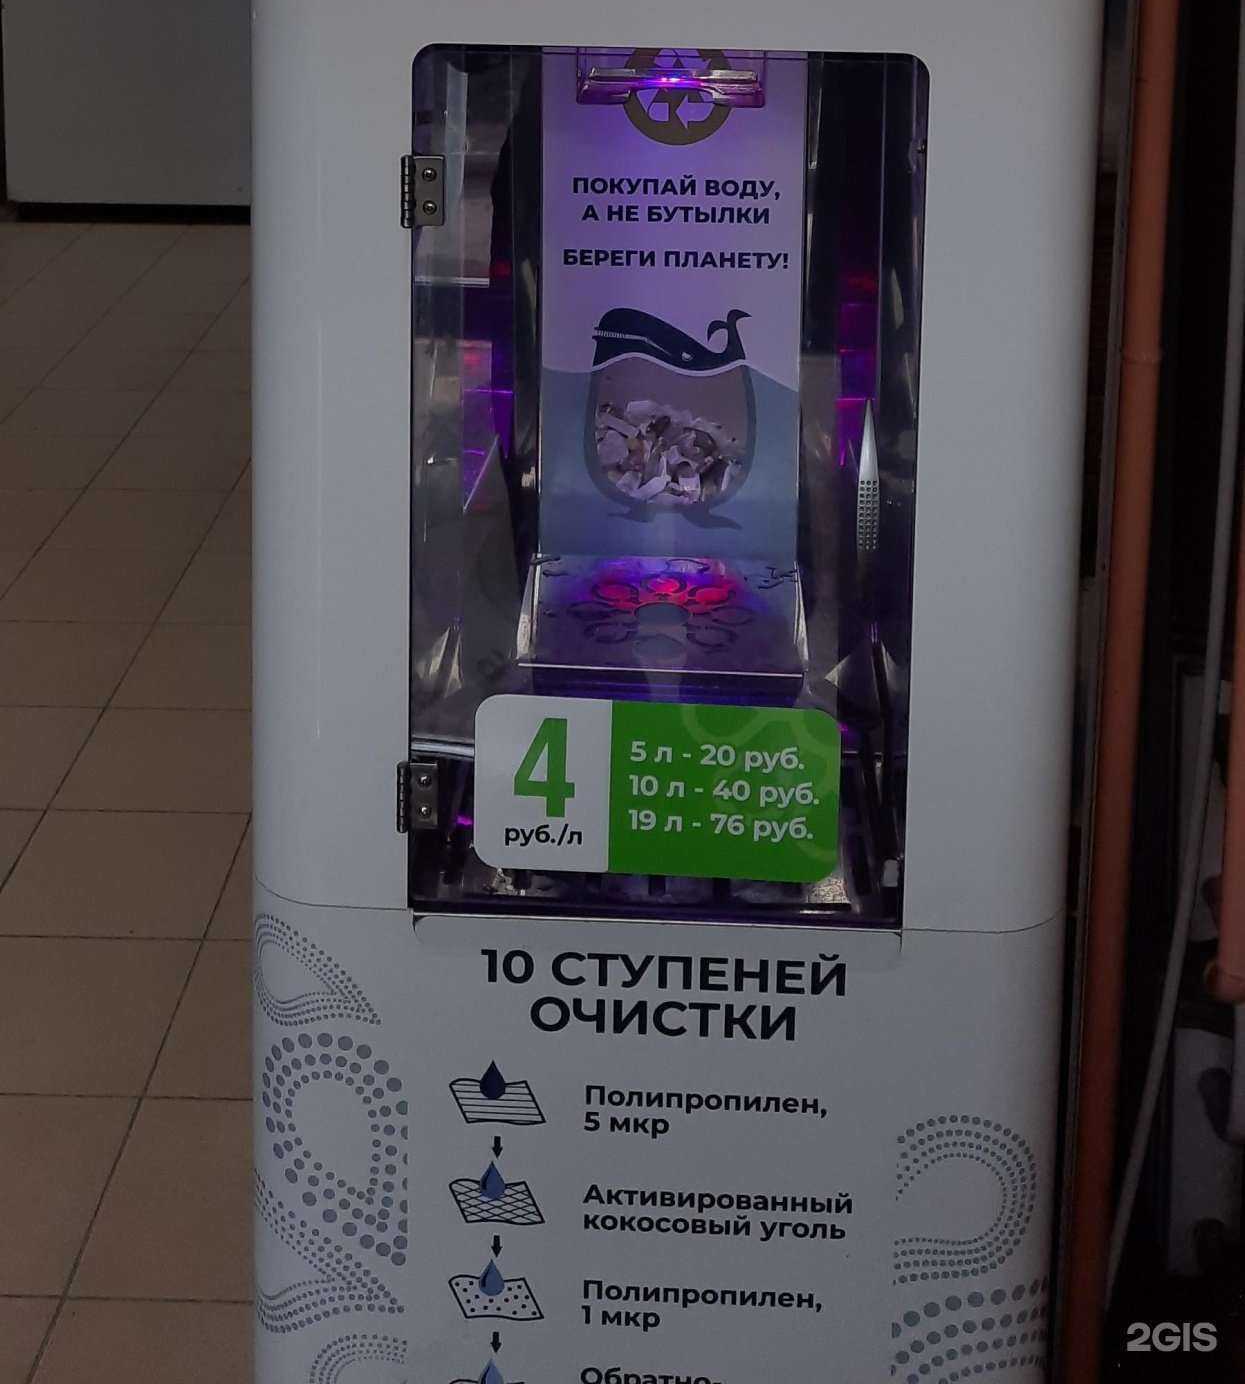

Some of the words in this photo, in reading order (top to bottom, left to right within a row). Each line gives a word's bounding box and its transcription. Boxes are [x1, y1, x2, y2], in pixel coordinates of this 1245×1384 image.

[573, 175, 696, 196] ПОКУПАЙ
[705, 178, 781, 200] ВОДУ,
[581, 205, 599, 221] А
[607, 205, 640, 222] НЕ
[648, 205, 770, 224] БУТЫЛКИ
[563, 249, 656, 266] БЕРЕГИ
[665, 251, 789, 270] ПЛАНЕТУ!
[513, 717, 575, 818] 4
[630, 741, 647, 763] 5
[654, 745, 673, 764] л
[700, 744, 736, 767] 20
[745, 747, 805, 773] руб.
[629, 775, 659, 798] 10
[666, 780, 685, 799] л
[712, 779, 751, 802] 40
[760, 782, 820, 808] руб.
[505, 824, 583, 847] руб./л
[629, 809, 657, 832] 19
[663, 814, 683, 833] л
[711, 813, 745, 836] 76
[753, 816, 814, 842] руб.
[481, 949, 535, 984] 10
[551, 952, 847, 996] СТУПЕНЕЙ
[530, 996, 796, 1041] ОЧИСТКИ
[585, 1085, 828, 1118] Полипропилен,
[583, 1112, 600, 1133] 5
[609, 1115, 670, 1139] мкр
[583, 1183, 854, 1215] Активированный
[583, 1214, 751, 1237] кокосовый
[760, 1219, 847, 1242] уголь
[583, 1279, 823, 1313] Полипропилен,
[582, 1306, 591, 1325] 1
[601, 1310, 661, 1332] мкр
